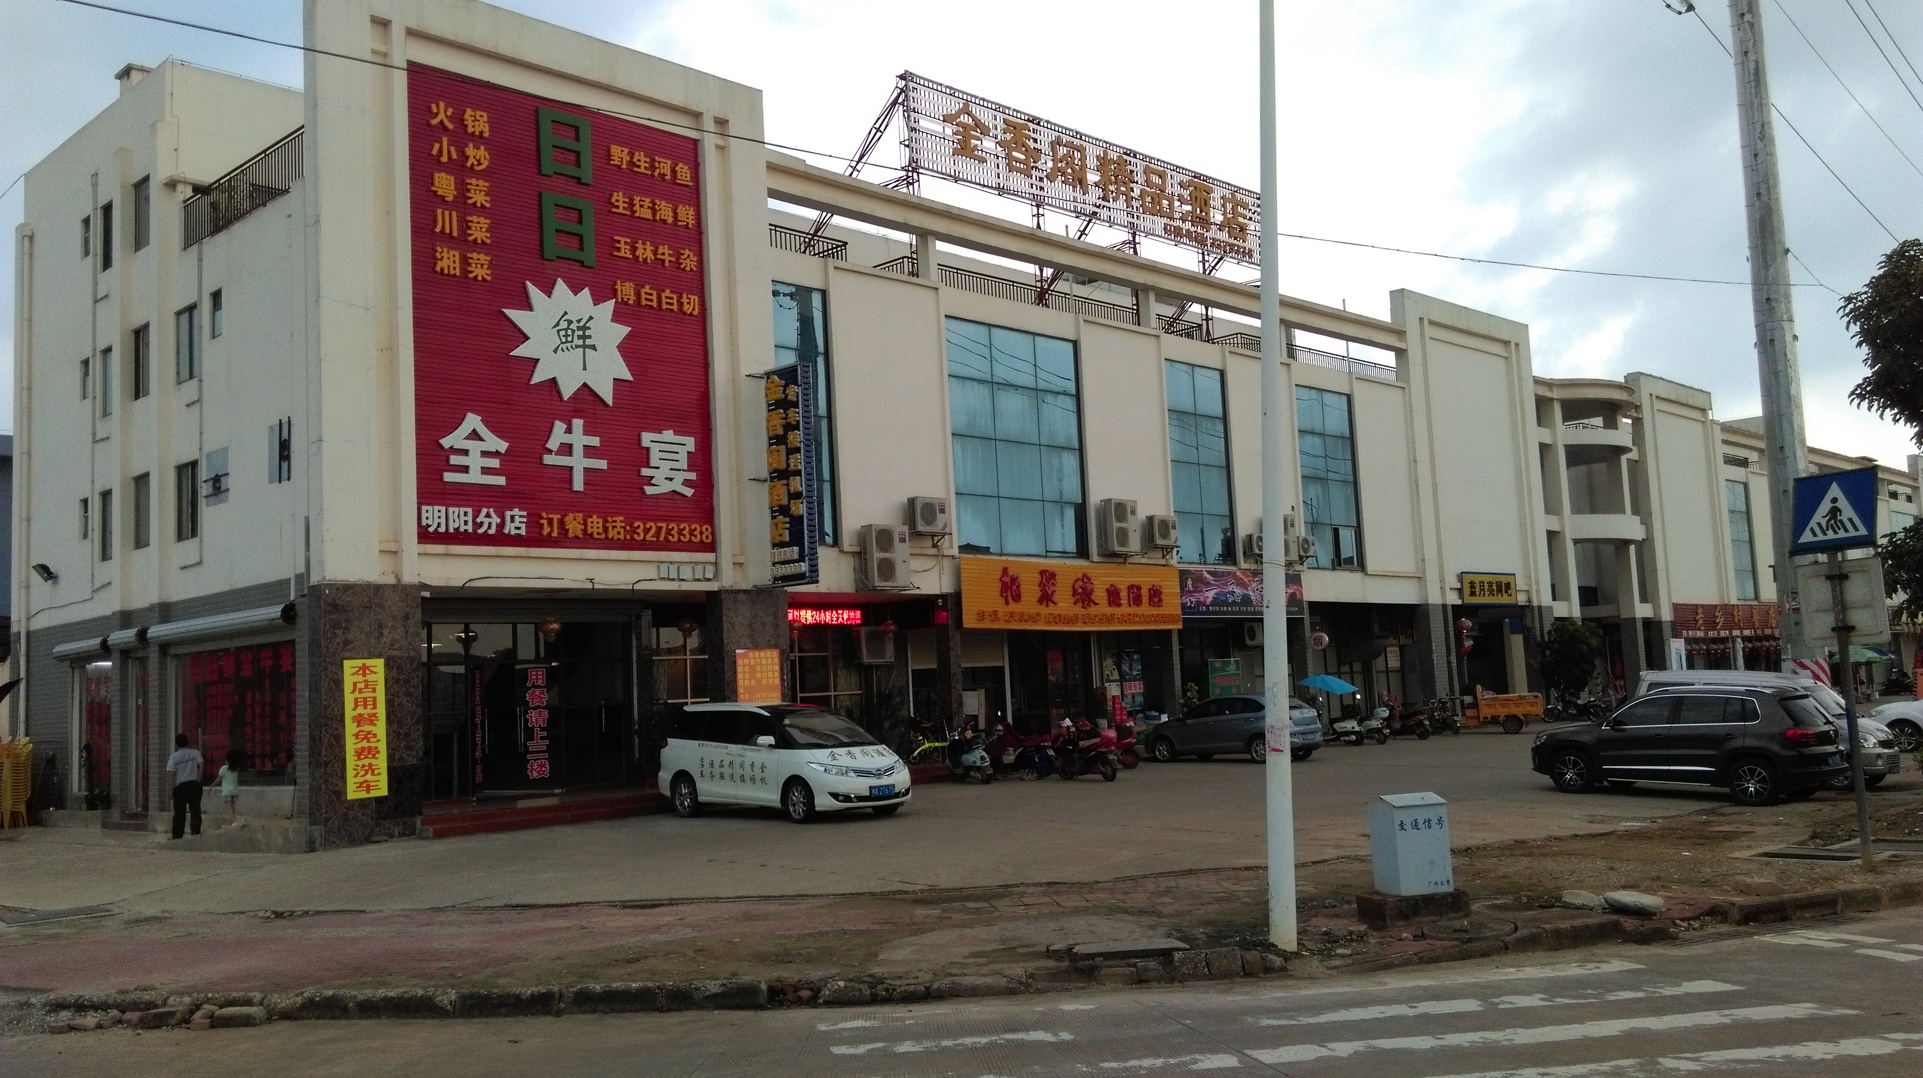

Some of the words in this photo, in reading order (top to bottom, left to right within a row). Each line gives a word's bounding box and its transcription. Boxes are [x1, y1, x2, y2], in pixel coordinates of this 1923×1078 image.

[429, 101, 490, 137] 火锅
[430, 137, 491, 171] 小炒
[608, 144, 694, 186] 野生河鱼
[430, 172, 491, 208] 粤菜
[434, 209, 492, 244] 川菜
[610, 192, 696, 228] 生猛海鲜
[434, 246, 493, 281] 湘菜
[612, 236, 698, 272] 玉林牛杂
[614, 280, 700, 315] 博白白切
[438, 412, 698, 497] 全牛宴
[420, 505, 528, 536] 明阳分店
[350, 663, 382, 794] 本店用餐免费洗车
[526, 668, 549, 779] 用餐请上二楼
[1398, 816, 1445, 832] 交通信号
